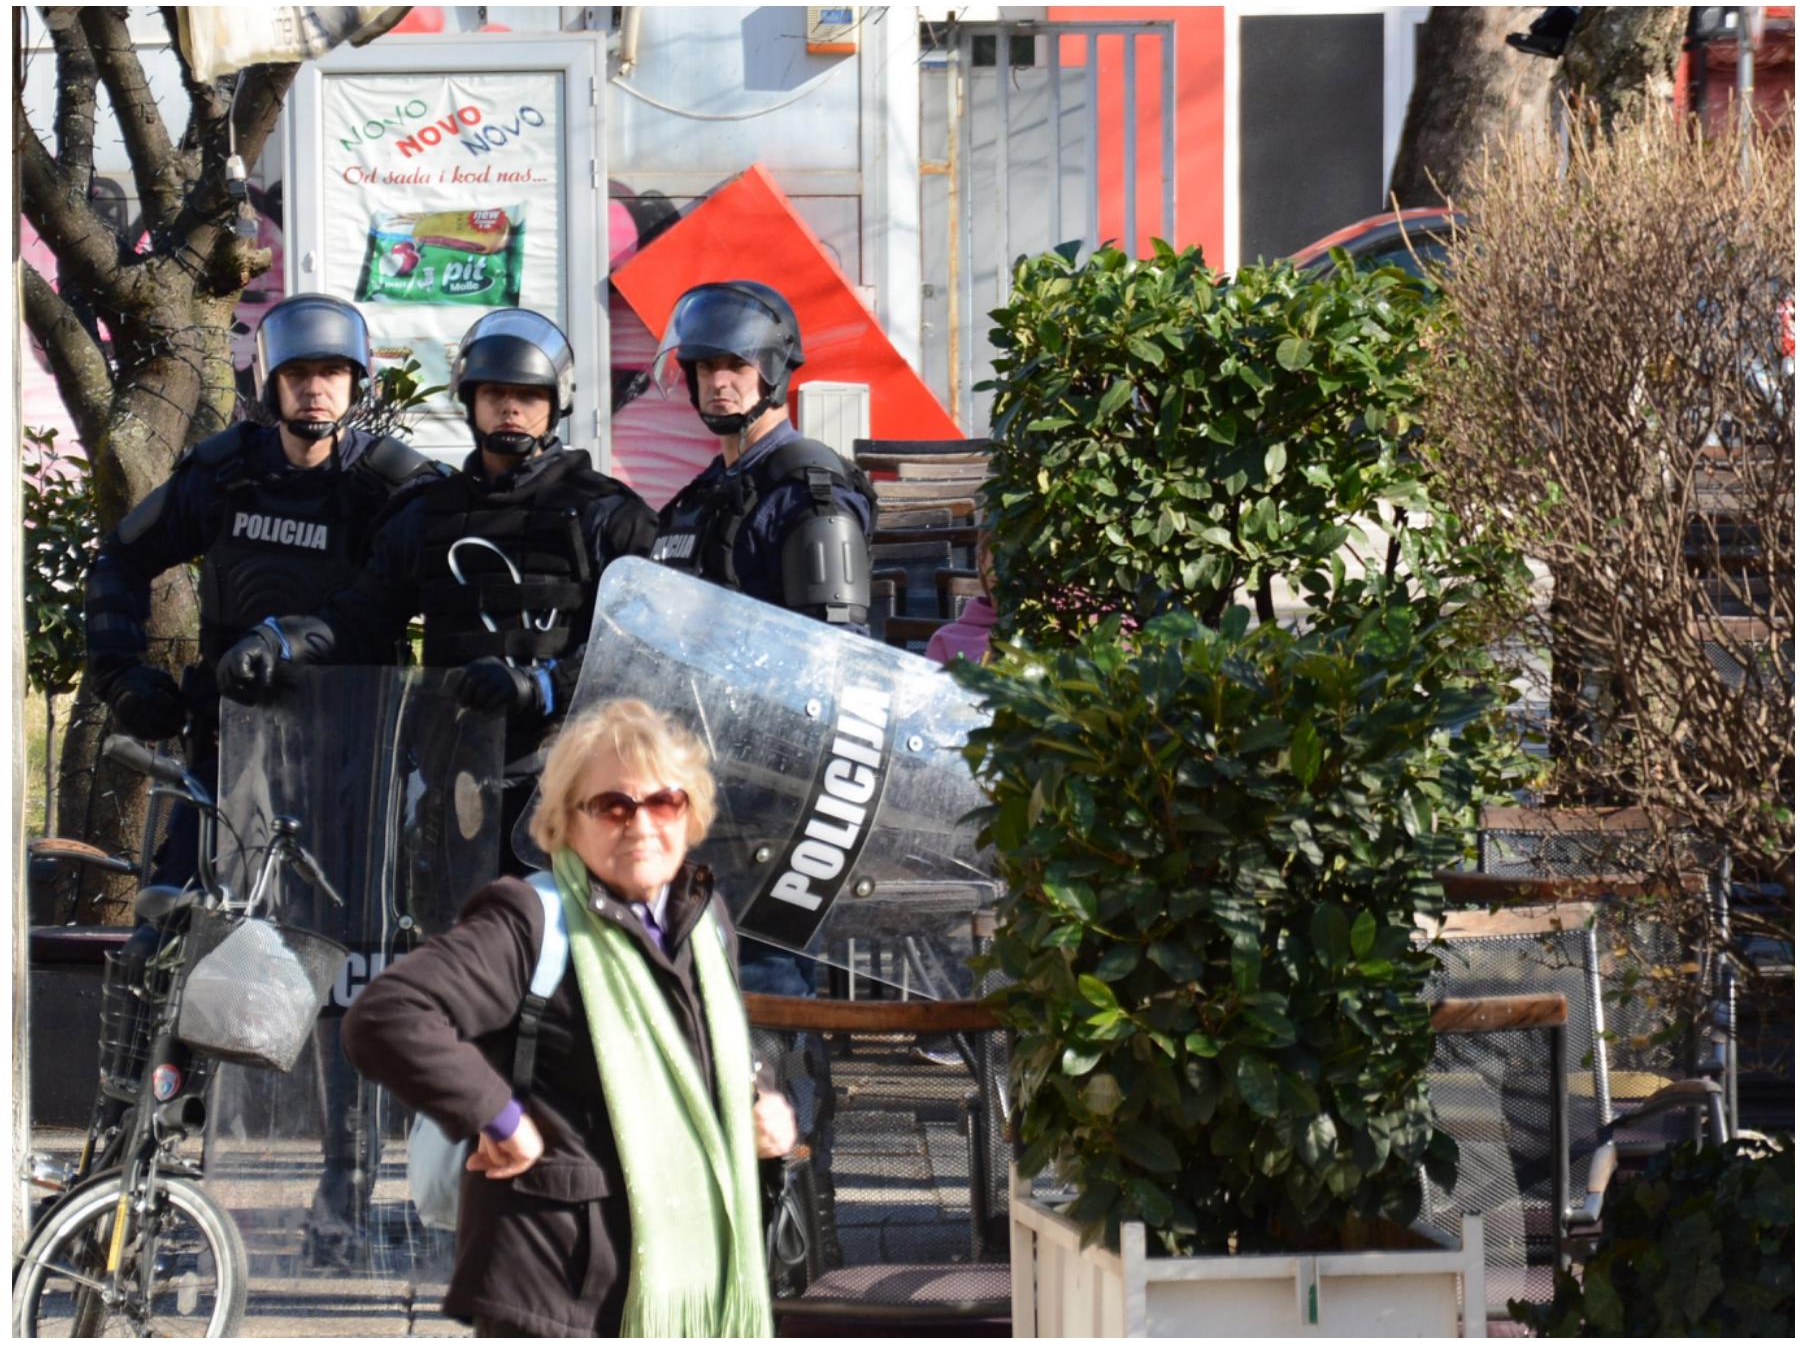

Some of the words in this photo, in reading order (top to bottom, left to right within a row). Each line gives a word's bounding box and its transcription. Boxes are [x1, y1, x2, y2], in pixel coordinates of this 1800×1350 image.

[340, 100, 428, 151] NOVO
[395, 105, 482, 158] NOVO
[460, 105, 545, 156] NOVO
[343, 165, 377, 185] Od
[383, 166, 431, 185] sada
[440, 169, 446, 183] i
[451, 165, 491, 183] kod
[442, 254, 488, 287] pit
[232, 512, 328, 550] POLICIJA
[770, 684, 890, 912] POLICIJA
